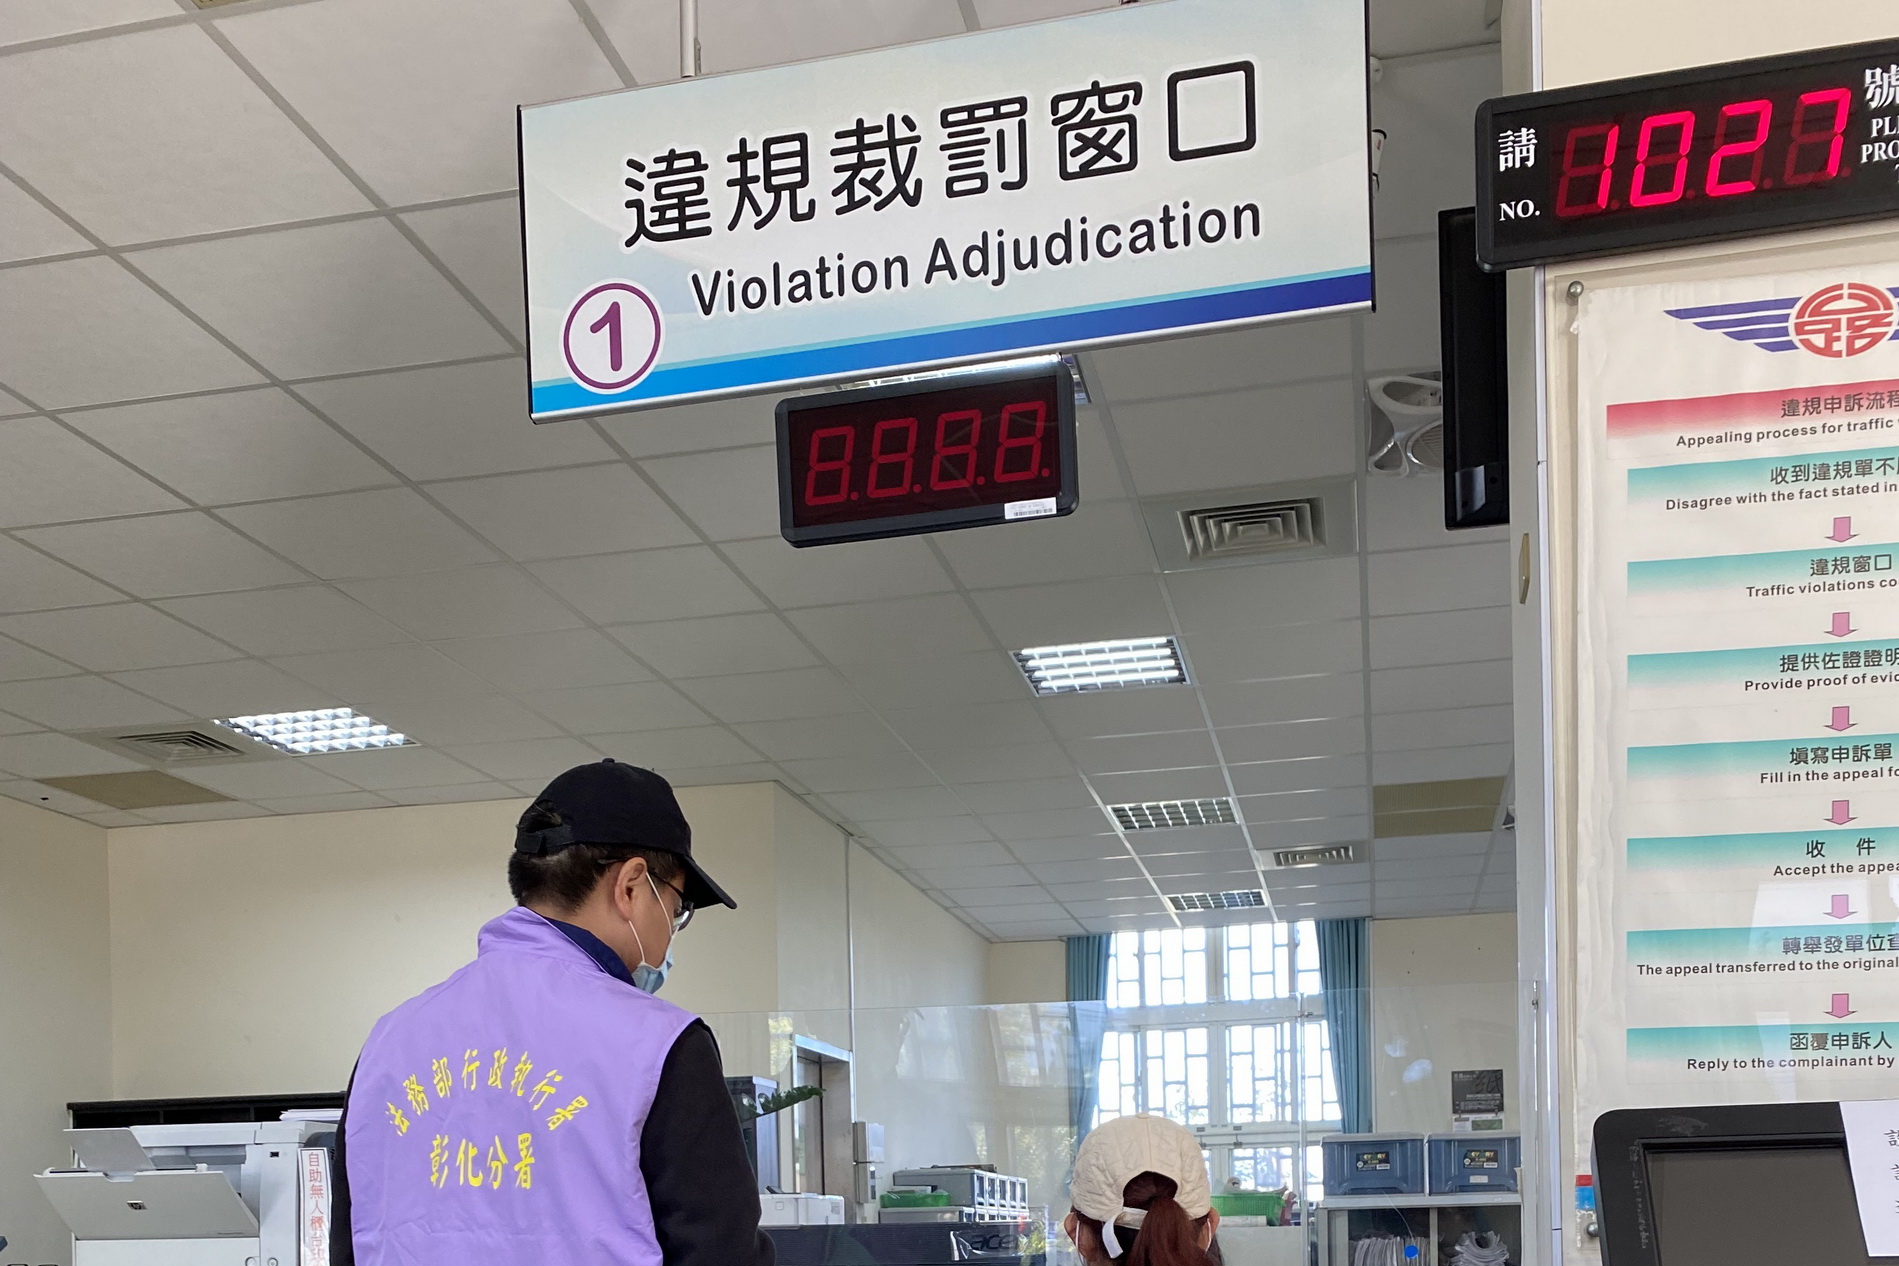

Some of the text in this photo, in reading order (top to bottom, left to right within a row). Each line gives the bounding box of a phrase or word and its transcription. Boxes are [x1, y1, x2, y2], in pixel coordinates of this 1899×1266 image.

[1863, 64, 1899, 111] 號
[1870, 115, 1899, 138] PL
[622, 59, 1258, 249] 違規裁罰窗口
[1497, 126, 1538, 172] 請
[1597, 87, 1852, 210] 1027
[1498, 198, 1541, 222] NO.
[691, 201, 1262, 318] Violation Adjudication
[1676, 417, 1894, 448] Appealing process for traffic
[1769, 456, 1899, 486] 收到違規單不
[1666, 480, 1898, 511] Disagree with the fact stated in
[1809, 554, 1892, 577] 違規窗口
[1746, 584, 1795, 597] Traffic
[1799, 578, 1875, 594] violations
[1779, 647, 1899, 673] 提供佐證證明
[1744, 678, 1803, 691] Provide
[1807, 674, 1848, 690] proof
[1851, 673, 1868, 685] of
[1760, 772, 1783, 784] Fill
[1787, 771, 1801, 782] in
[1805, 769, 1829, 781] the
[1833, 766, 1884, 782] appeal
[1773, 863, 1827, 877] Accept
[1830, 863, 1854, 874] the
[1637, 956, 1899, 977] The appeal transferred to the original
[1788, 1031, 1893, 1051] 函覆申訴人
[1687, 1055, 1896, 1072] Reply to the complainant by
[430, 1132, 536, 1190] 彰化分署
